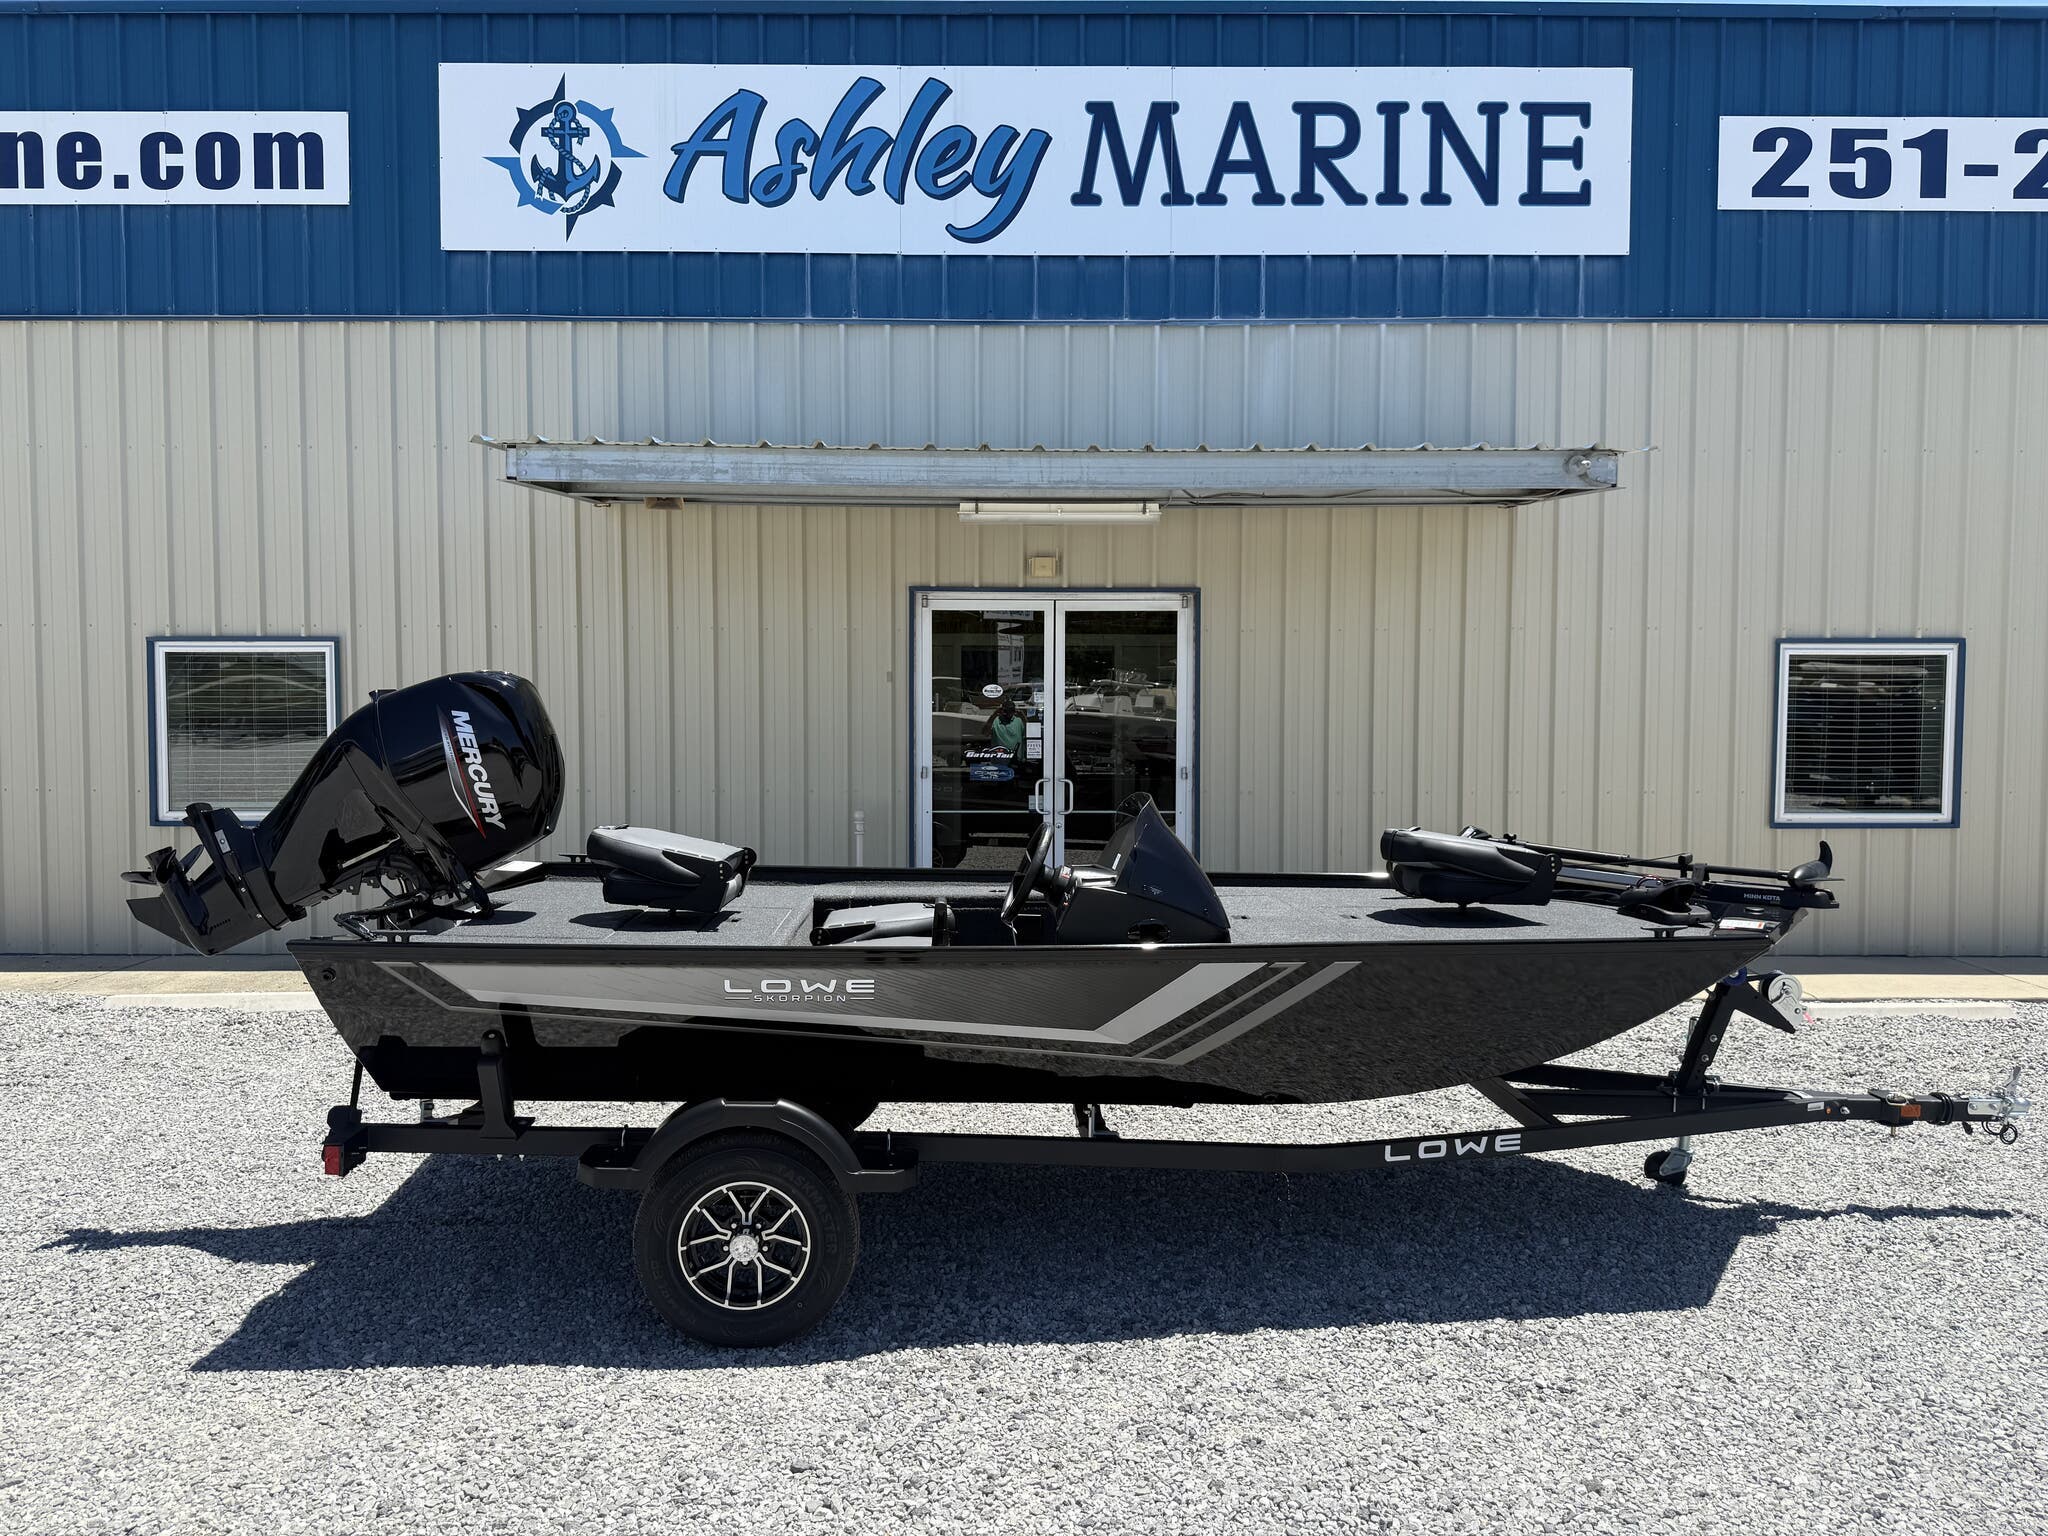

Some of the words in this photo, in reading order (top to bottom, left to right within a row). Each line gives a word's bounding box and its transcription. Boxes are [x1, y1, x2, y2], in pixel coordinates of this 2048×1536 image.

[0, 130, 326, 191] ne.com
[662, 75, 1054, 245] Ashley
[1069, 100, 1593, 208] MARINE
[1750, 126, 2048, 200] 251-2
[450, 709, 507, 830] MERCURY
[723, 979, 875, 993] LOWE
[753, 994, 846, 1002] SKORPION
[1384, 1133, 1522, 1163] LOWE
